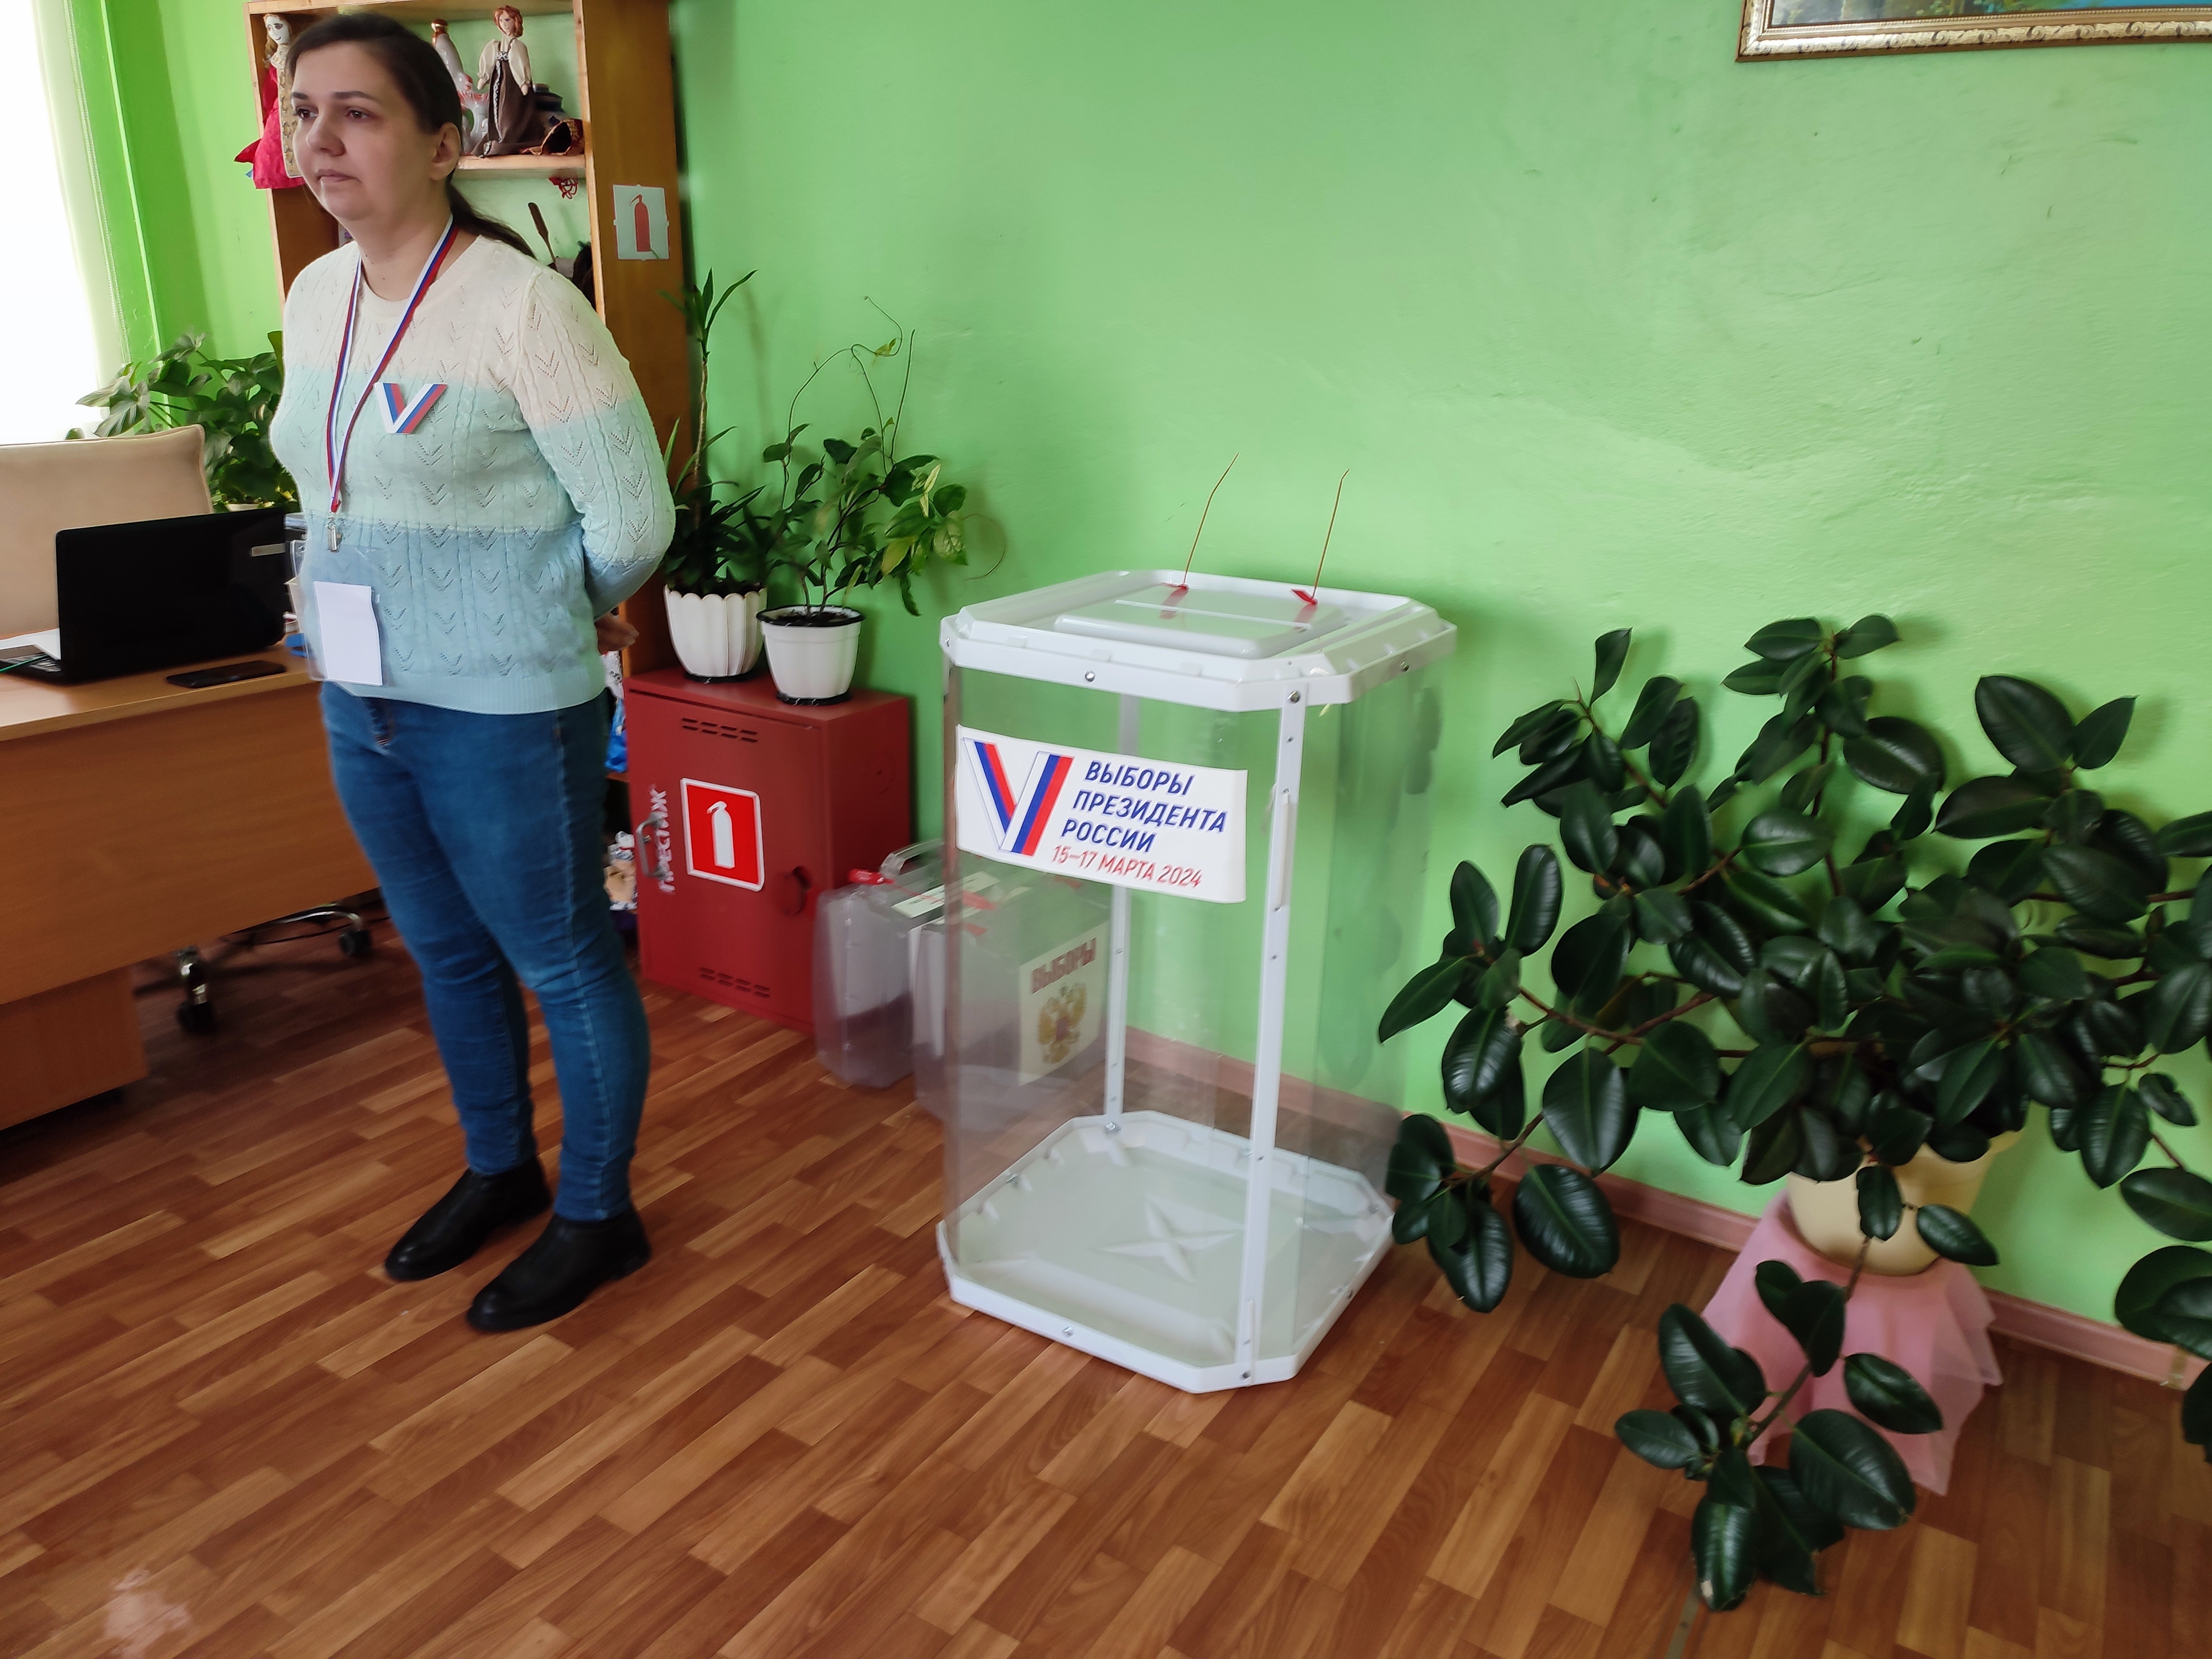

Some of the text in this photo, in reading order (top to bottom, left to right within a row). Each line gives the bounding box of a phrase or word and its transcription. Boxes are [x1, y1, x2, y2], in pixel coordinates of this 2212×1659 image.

[1084, 760, 1194, 796] ВЫБОРЫ
[1072, 790, 1228, 833] ПРЕЗИДЕНТА
[1061, 818, 1157, 853] РОССИИ
[1097, 855, 1155, 882] МАРТА
[1157, 865, 1203, 888] 2024
[1031, 937, 1097, 994] ВЫБОРЫ
